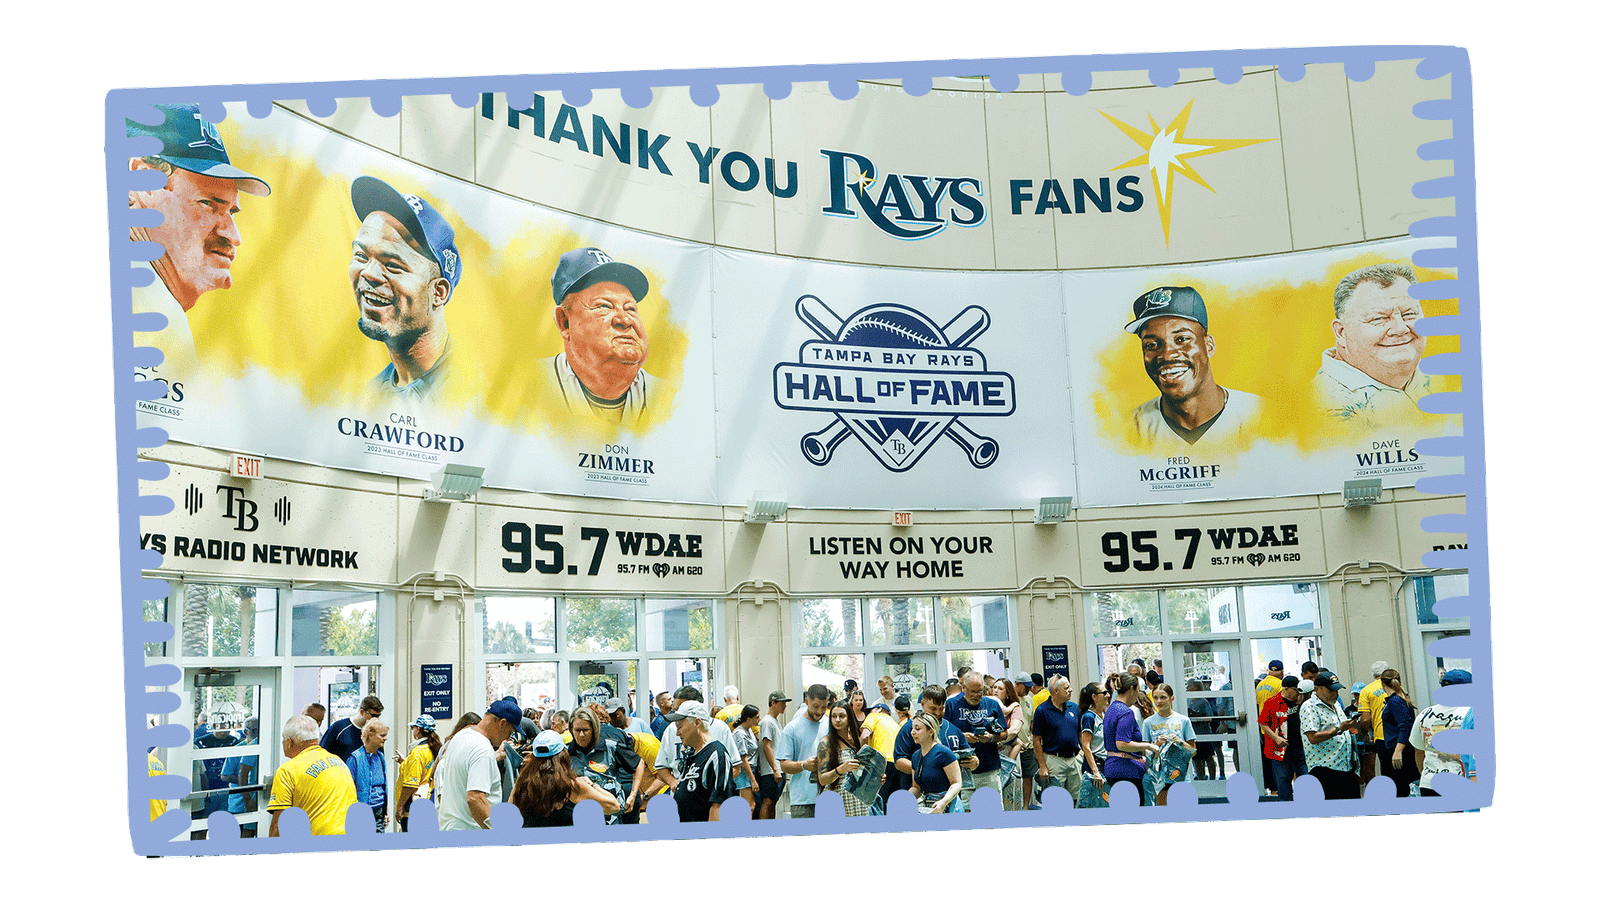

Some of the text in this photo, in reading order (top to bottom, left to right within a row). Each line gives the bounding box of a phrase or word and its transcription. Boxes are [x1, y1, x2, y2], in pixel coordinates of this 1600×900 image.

[936, 90, 1003, 100] LORIDA
[686, 141, 798, 198] YOU
[1009, 175, 1145, 216] FANS
[812, 347, 974, 367] TAMPA BAY RAYS
[784, 372, 1006, 406] HALL OF FAME
[138, 401, 180, 416] FAME CLASS
[389, 412, 417, 427] CARL
[337, 417, 465, 453] CRAWFORD
[1372, 439, 1400, 450] DAVE
[367, 445, 382, 453] 2023
[382, 447, 397, 455] HALL
[405, 451, 421, 459] FAME
[421, 453, 438, 461] CLASS
[605, 443, 629, 455] DON
[890, 439, 906, 455] TB
[237, 456, 261, 477] EXIT
[578, 452, 655, 474] ZIMMER
[1167, 456, 1190, 465] FRED
[1356, 448, 1419, 467] WILLS
[216, 484, 259, 532] TB
[894, 512, 911, 525] EXIT
[174, 535, 246, 562] RADIO
[252, 543, 359, 570] NETWORK
[501, 521, 702, 576] 95.7 WDAE
[809, 536, 994, 555] LISTEN ON YOUR
[1101, 524, 1299, 573] 95.7 WDAE
[1211, 553, 1301, 565] 95.7 FM AM 620
[617, 564, 703, 575] 95.7 FM AM 620
[839, 560, 964, 579] WAY HOME
[306, 759, 329, 778] FAN
